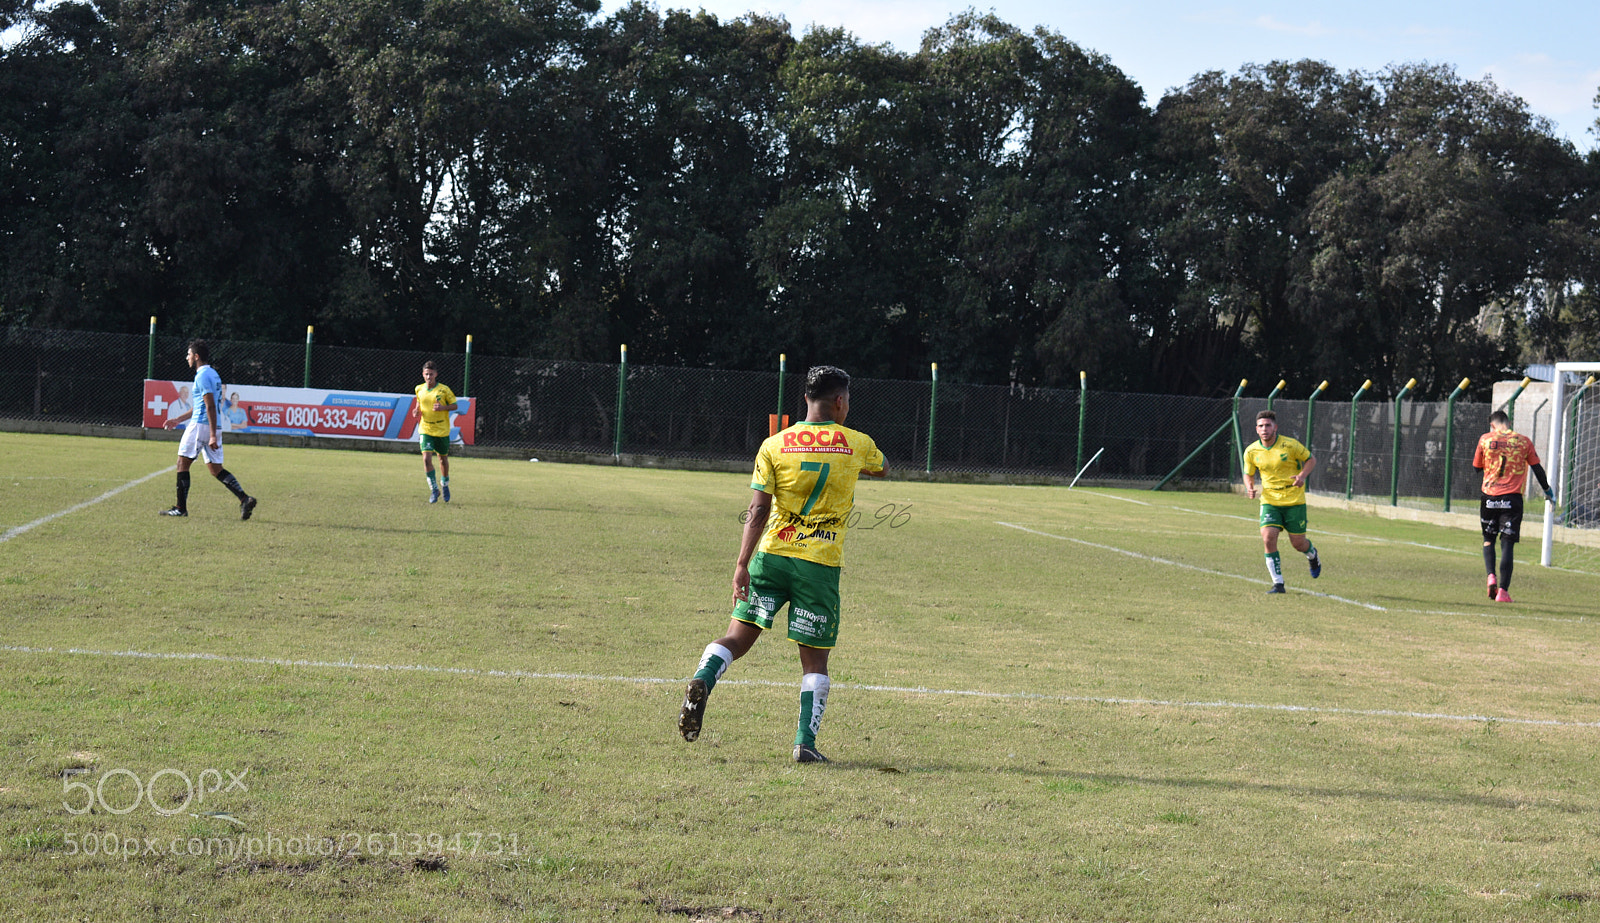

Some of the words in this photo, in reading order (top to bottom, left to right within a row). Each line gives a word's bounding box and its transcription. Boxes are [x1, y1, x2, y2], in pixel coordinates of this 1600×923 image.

[257, 412, 280, 425] 24HS
[286, 406, 386, 431] 0800-333-4670
[783, 431, 849, 447] ROCA
[800, 461, 830, 516] 7
